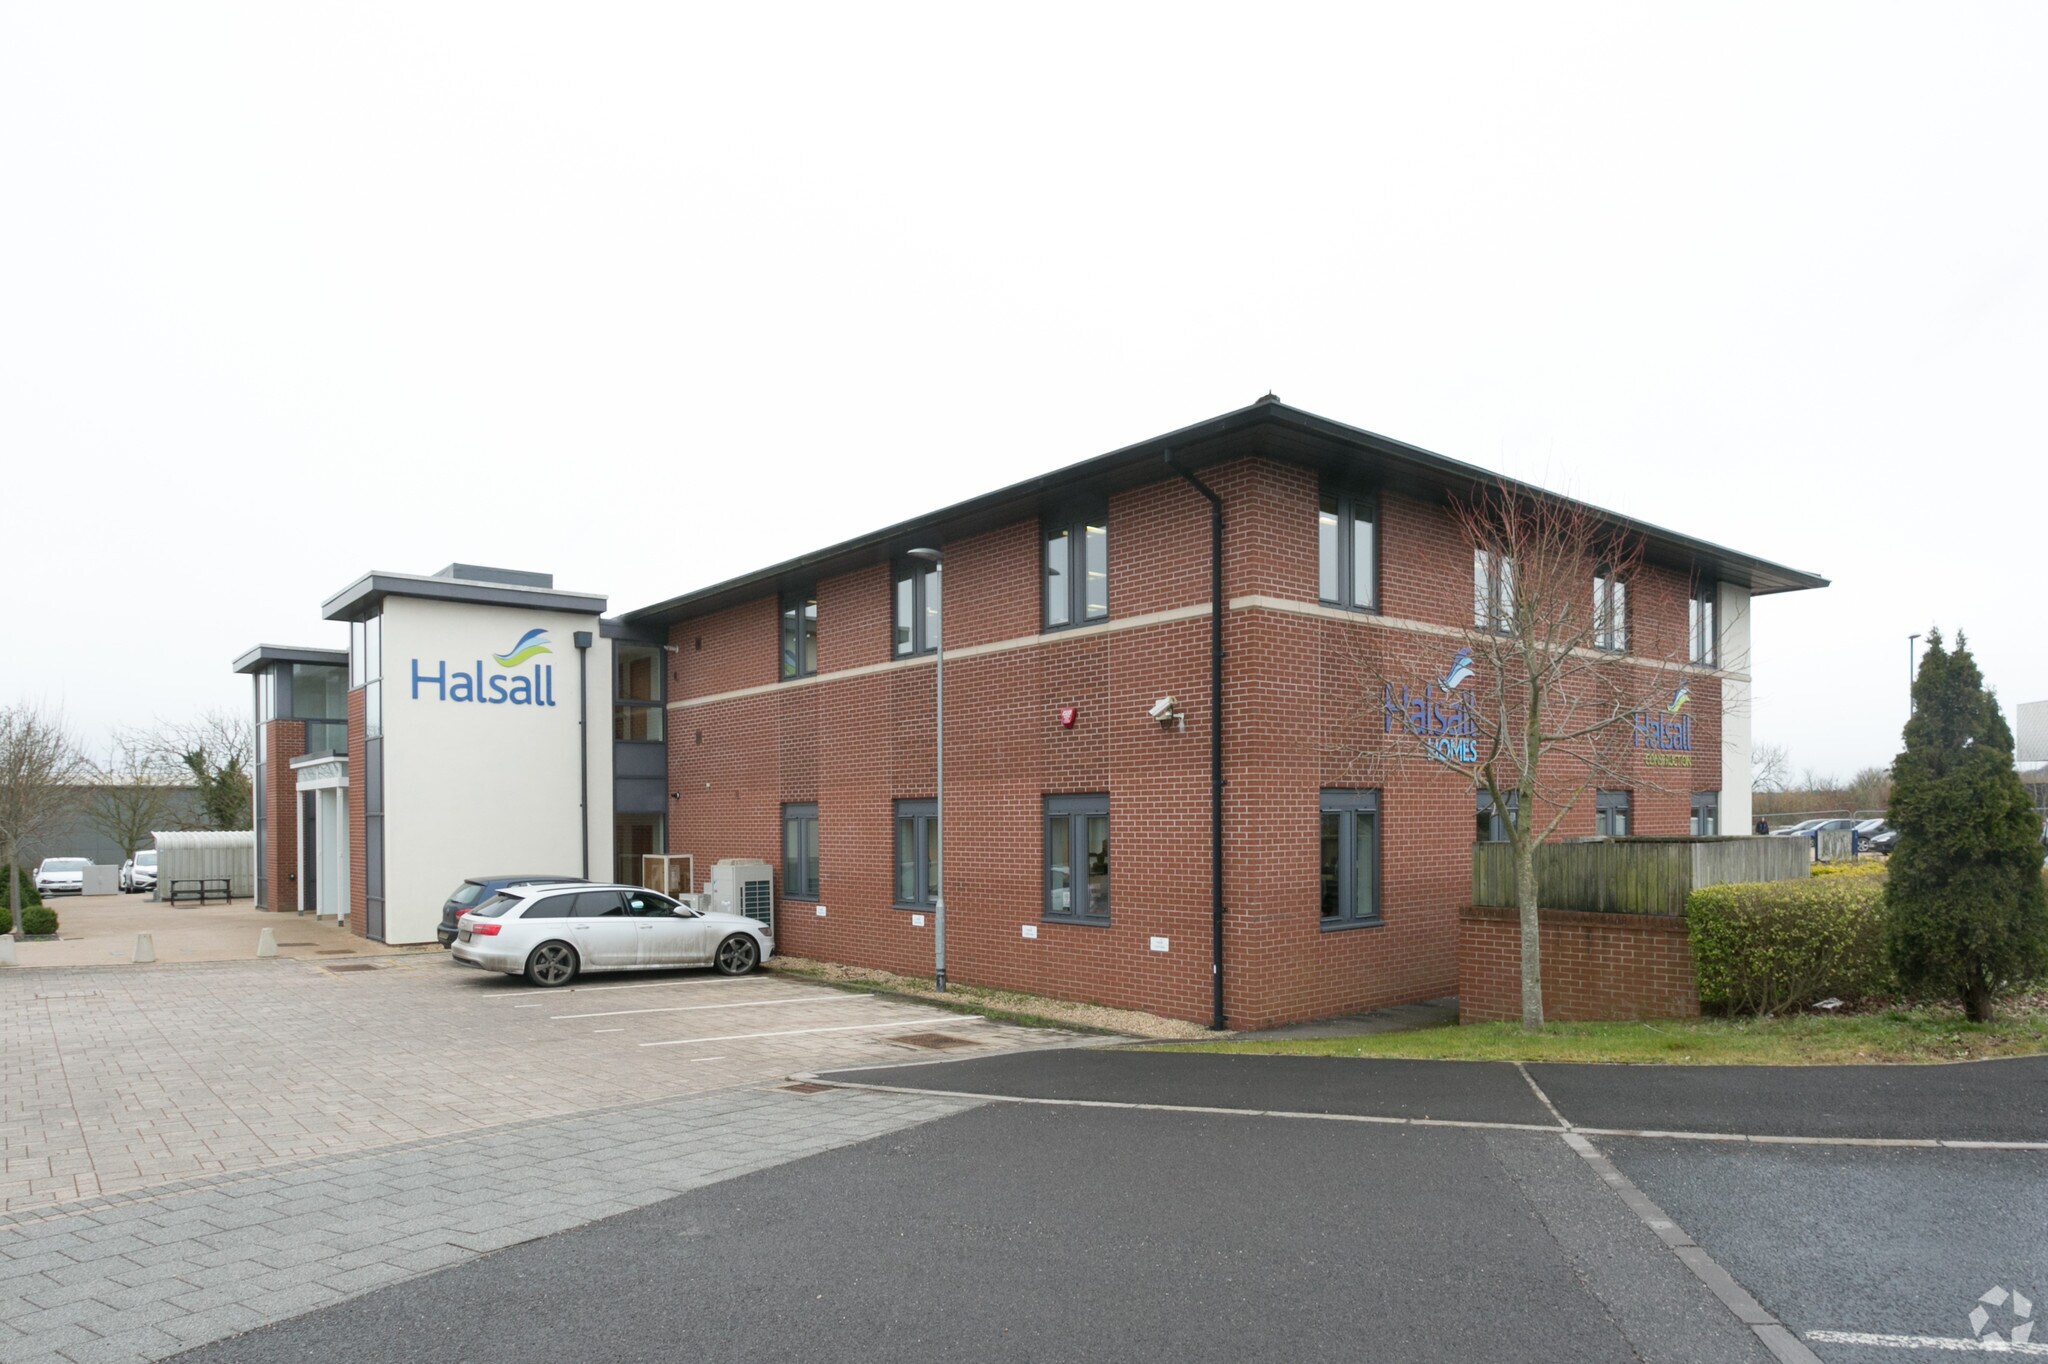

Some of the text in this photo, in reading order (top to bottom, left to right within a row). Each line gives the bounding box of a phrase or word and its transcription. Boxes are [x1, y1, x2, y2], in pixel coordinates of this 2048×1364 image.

[411, 658, 556, 707] Halsall
[1384, 682, 1478, 738] Halsall
[1633, 711, 1692, 751] Halsall
[1426, 737, 1478, 762] HOMES
